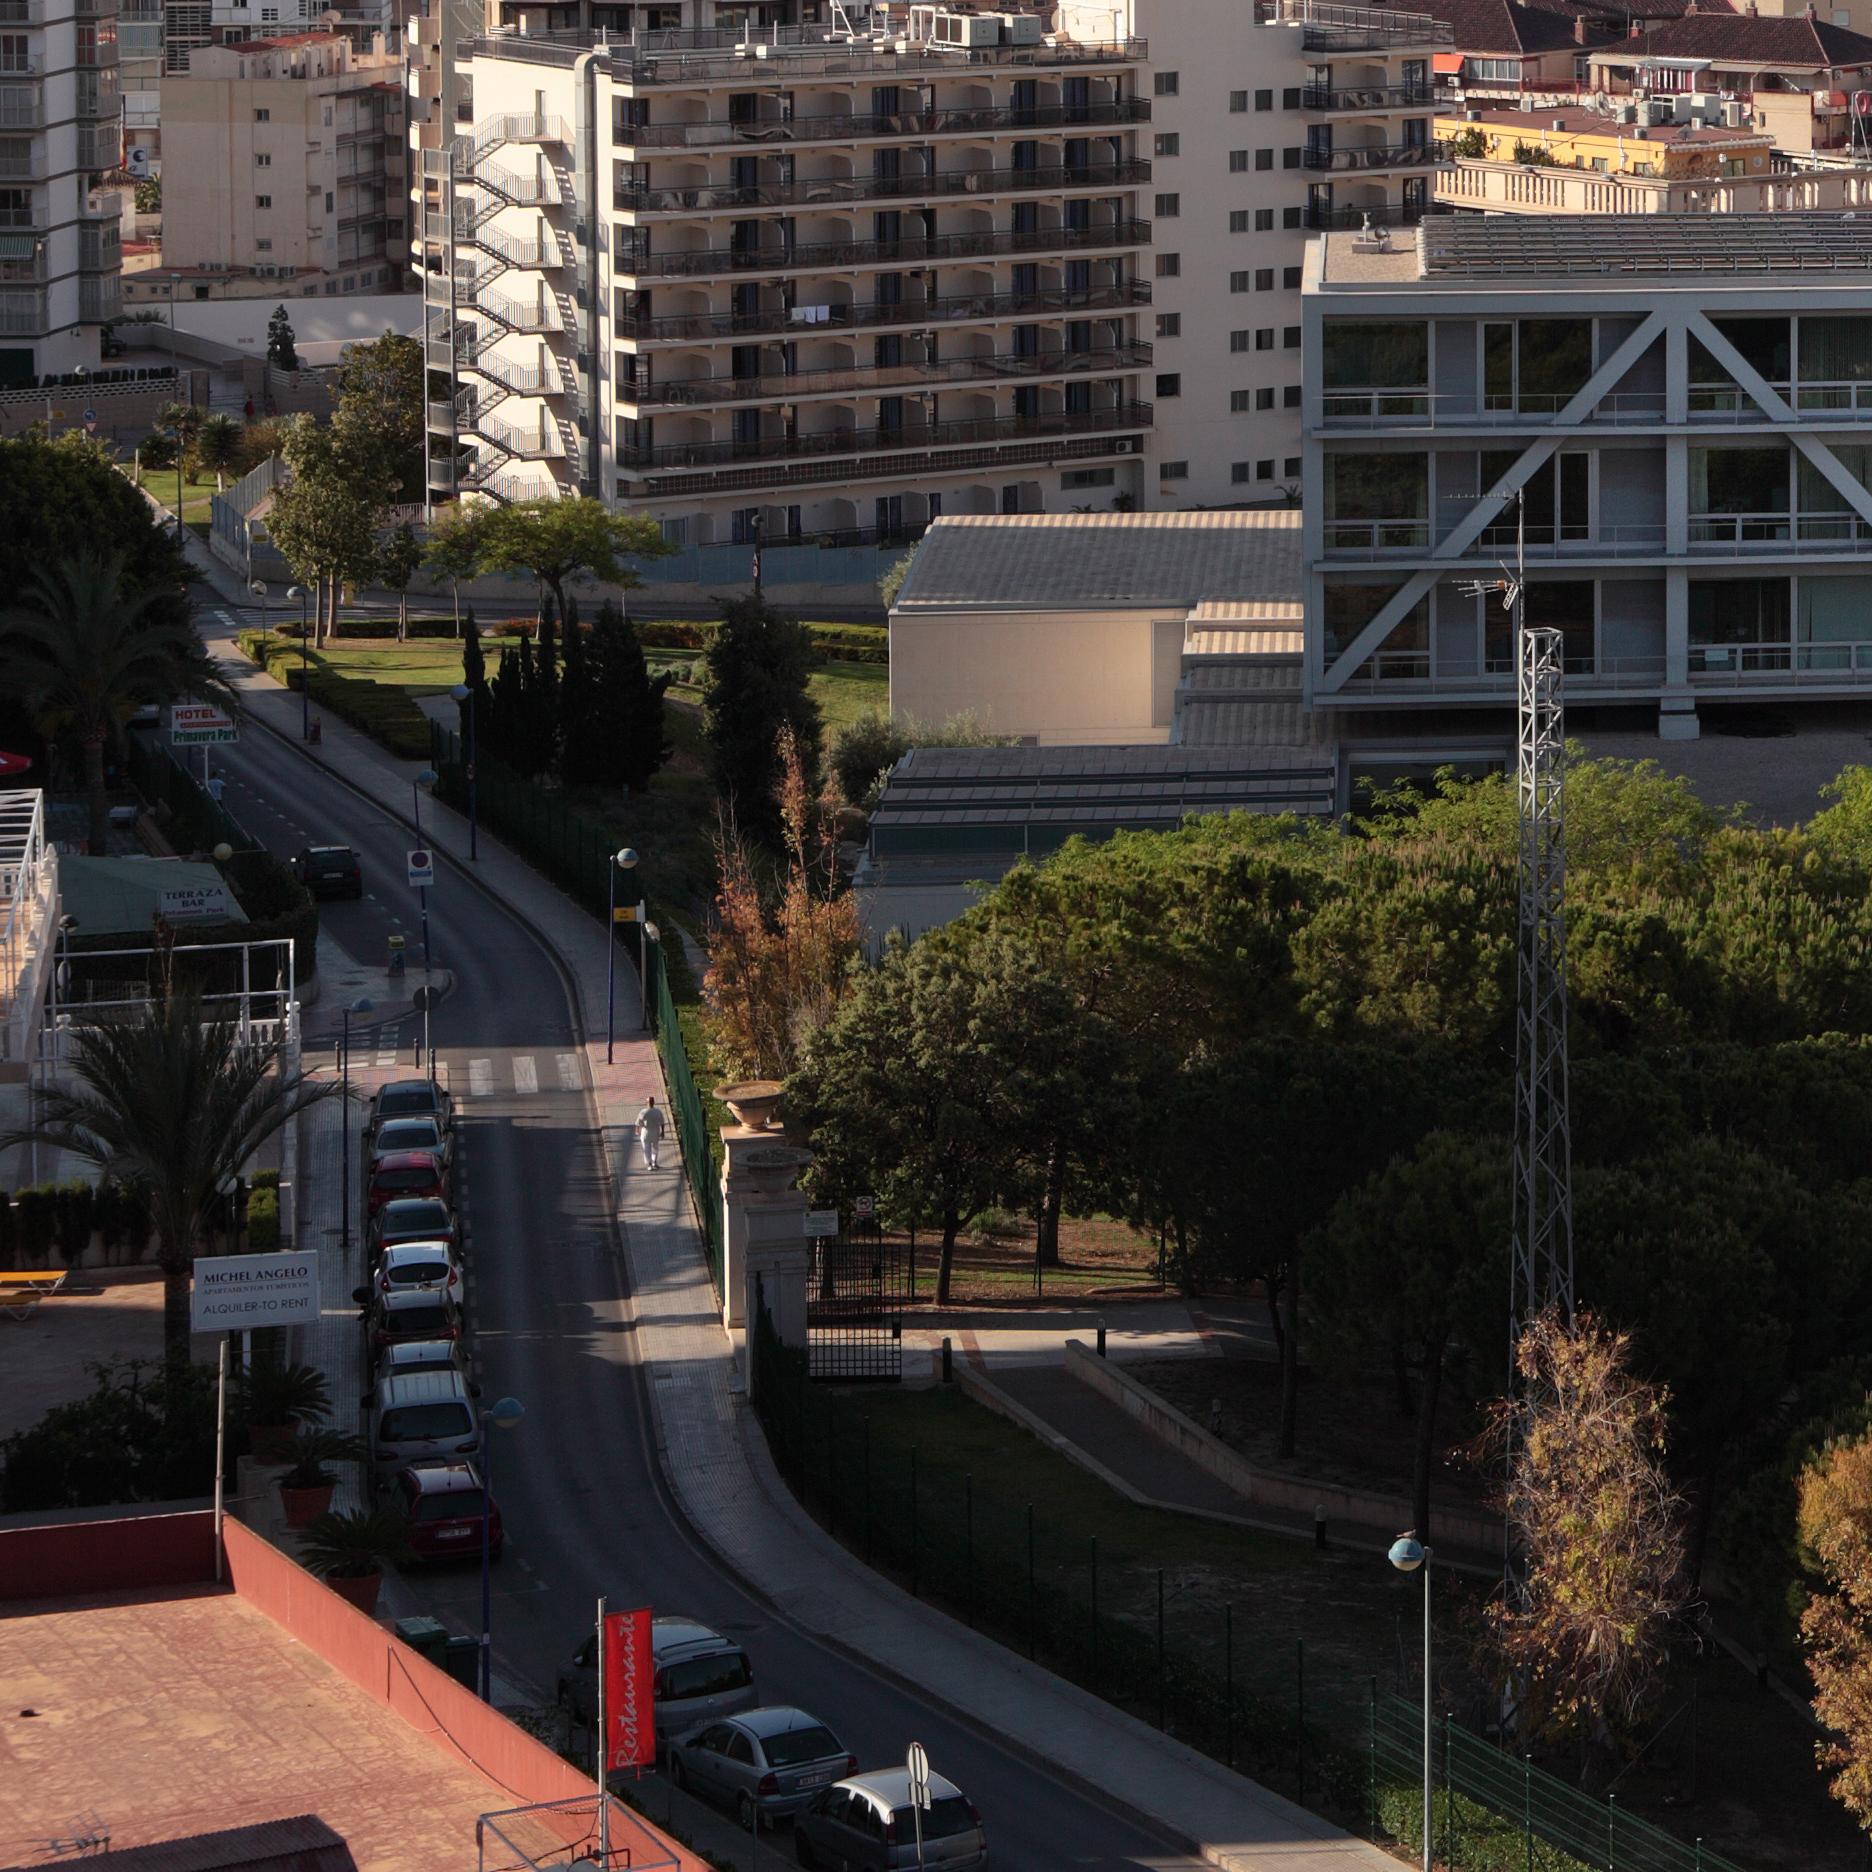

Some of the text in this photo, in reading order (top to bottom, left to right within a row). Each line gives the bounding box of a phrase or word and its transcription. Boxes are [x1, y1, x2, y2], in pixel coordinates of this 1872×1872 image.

[175, 709, 216, 719] HOTEL
[218, 728, 239, 741] Park
[165, 888, 223, 900] TERRAZA
[182, 898, 205, 908] BAR
[203, 1267, 308, 1284] MICHEL ANGELO
[281, 1297, 309, 1309] RENT
[615, 1613, 639, 1768] Restaurante
